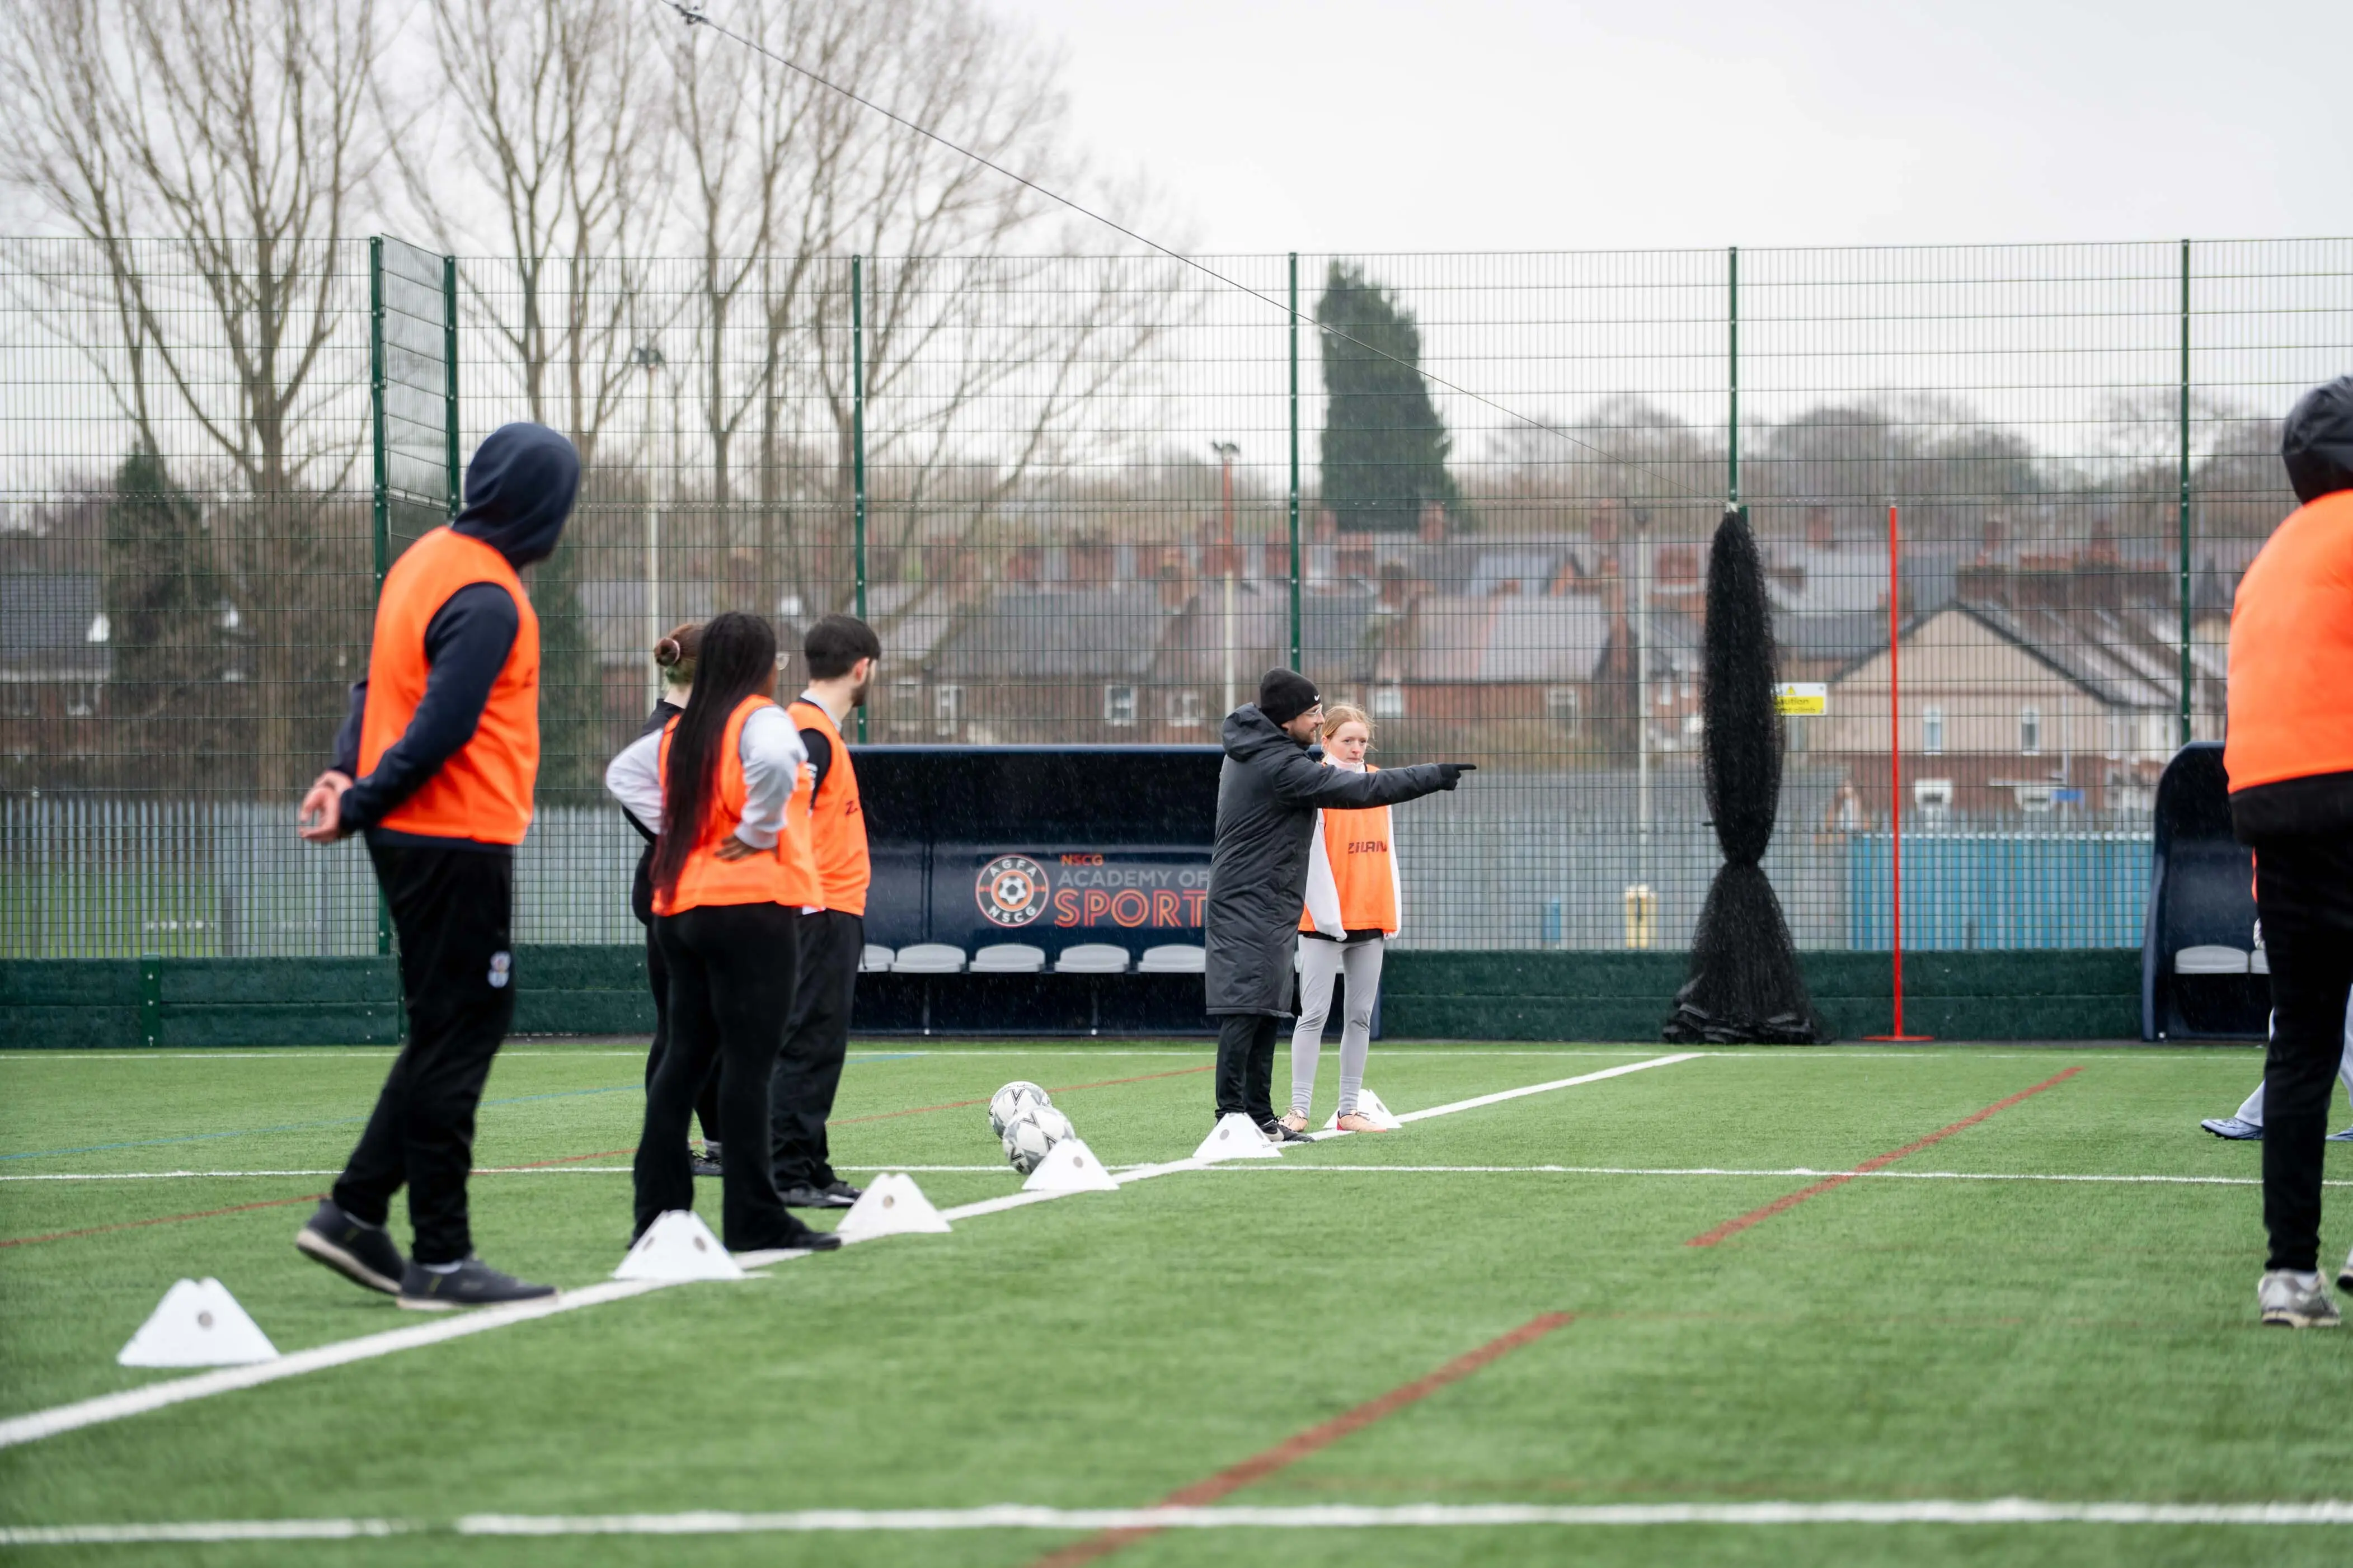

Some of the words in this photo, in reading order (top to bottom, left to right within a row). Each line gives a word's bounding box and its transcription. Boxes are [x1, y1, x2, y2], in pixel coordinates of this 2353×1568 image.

[989, 858, 1037, 877] AGFA
[1060, 854, 1104, 867] NSCG
[1058, 870, 1171, 887] ACADEMY
[1178, 869, 1209, 887] OF
[988, 905, 1037, 923] NSCG
[1054, 888, 1206, 927] SPORT
